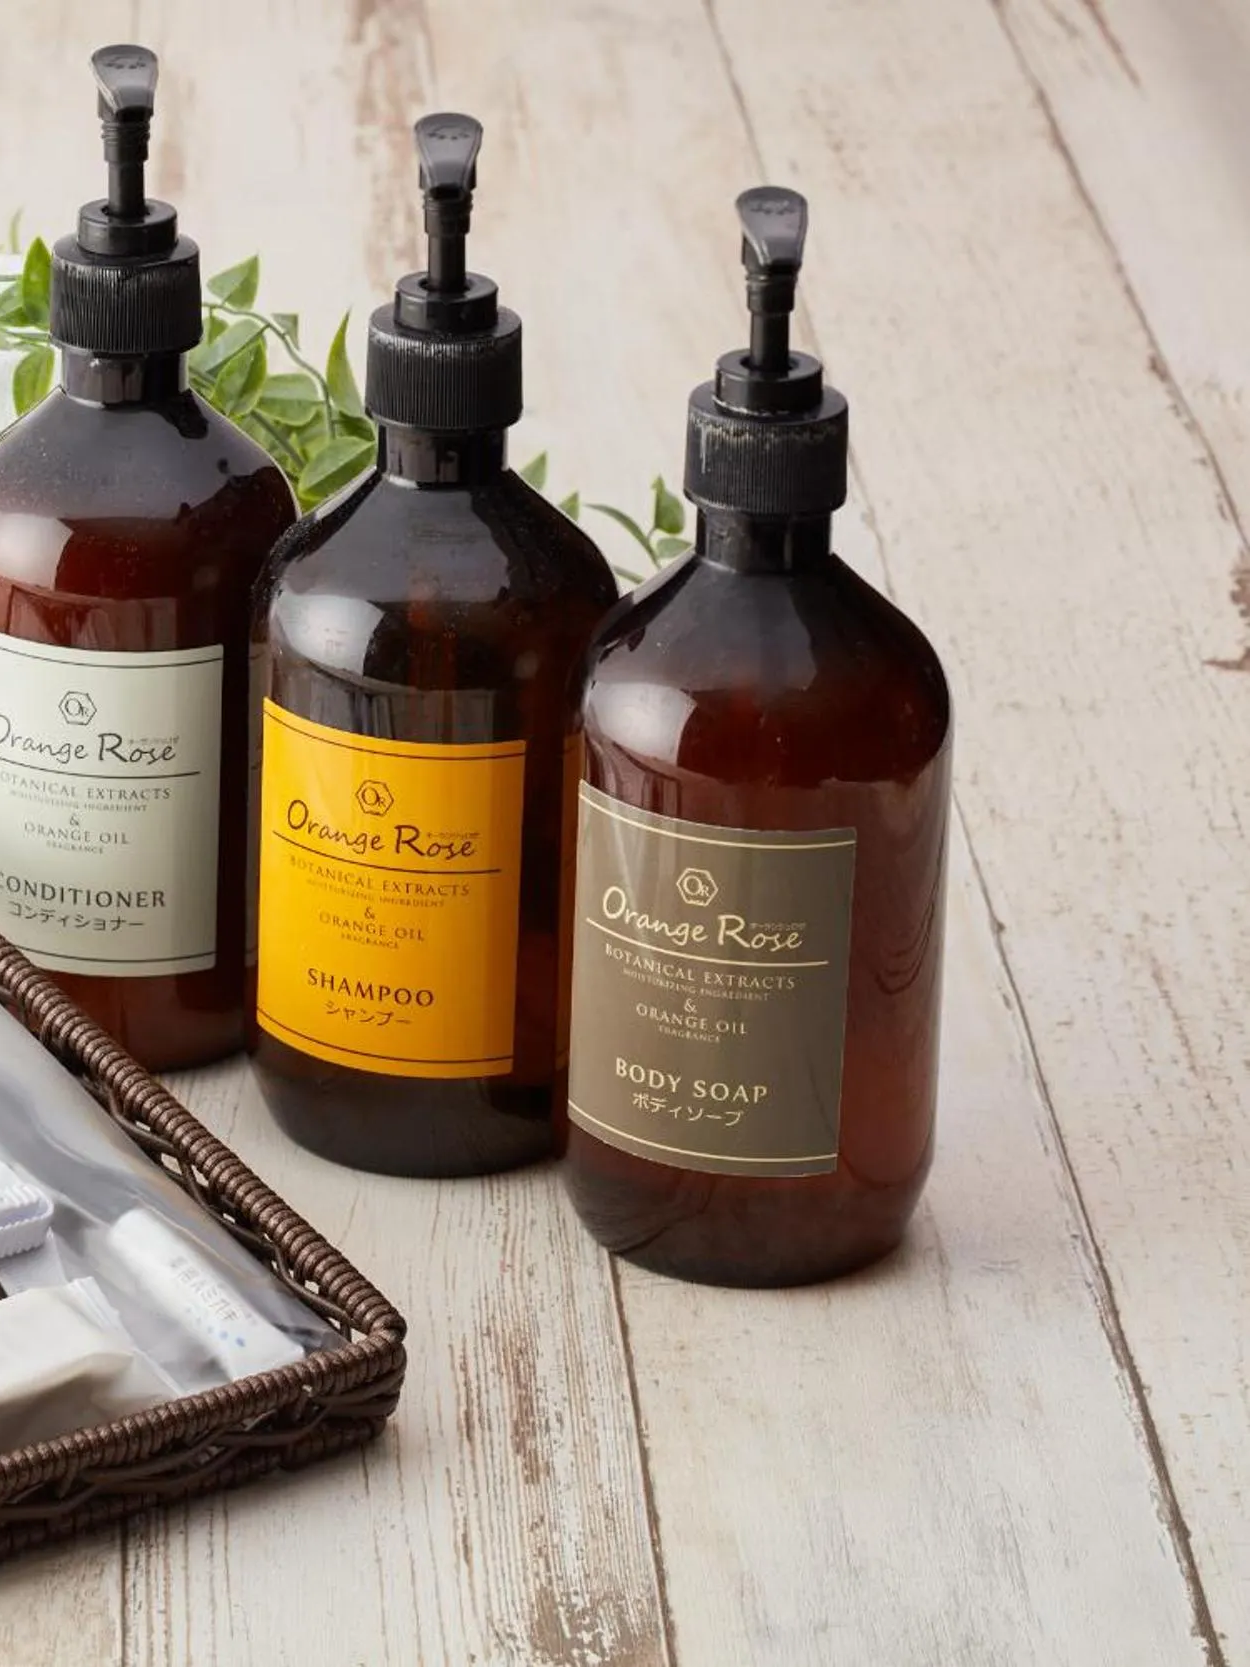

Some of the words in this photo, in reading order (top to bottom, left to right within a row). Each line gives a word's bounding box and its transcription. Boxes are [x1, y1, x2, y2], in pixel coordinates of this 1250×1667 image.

[98, 732, 177, 766] Rose
[87, 787, 171, 800] EXTRACTS
[23, 821, 92, 843] ORANGE
[99, 831, 131, 845] OIL
[69, 813, 80, 827] &
[287, 799, 385, 855] Orange
[394, 824, 476, 860] Rose
[289, 855, 374, 890] BOTANICAL
[382, 880, 471, 897] EXTRACTS
[8, 901, 146, 931] コンディショナー
[319, 911, 388, 937] ORANGE
[394, 927, 425, 942] OIL
[364, 906, 376, 920] &
[602, 885, 708, 945] Orange
[717, 914, 804, 952] Rose
[605, 943, 695, 982] BOTANICAL
[704, 971, 796, 990] EXTRACTS
[307, 967, 435, 1008] SHAMPOO
[324, 1000, 412, 1027] シャンプー
[636, 1003, 708, 1031] ORANGE
[716, 1020, 748, 1035] OIL
[683, 998, 698, 1013] &
[615, 1056, 682, 1094] BODY
[693, 1079, 768, 1104] SOAP
[632, 1092, 744, 1127] ボディソープ
